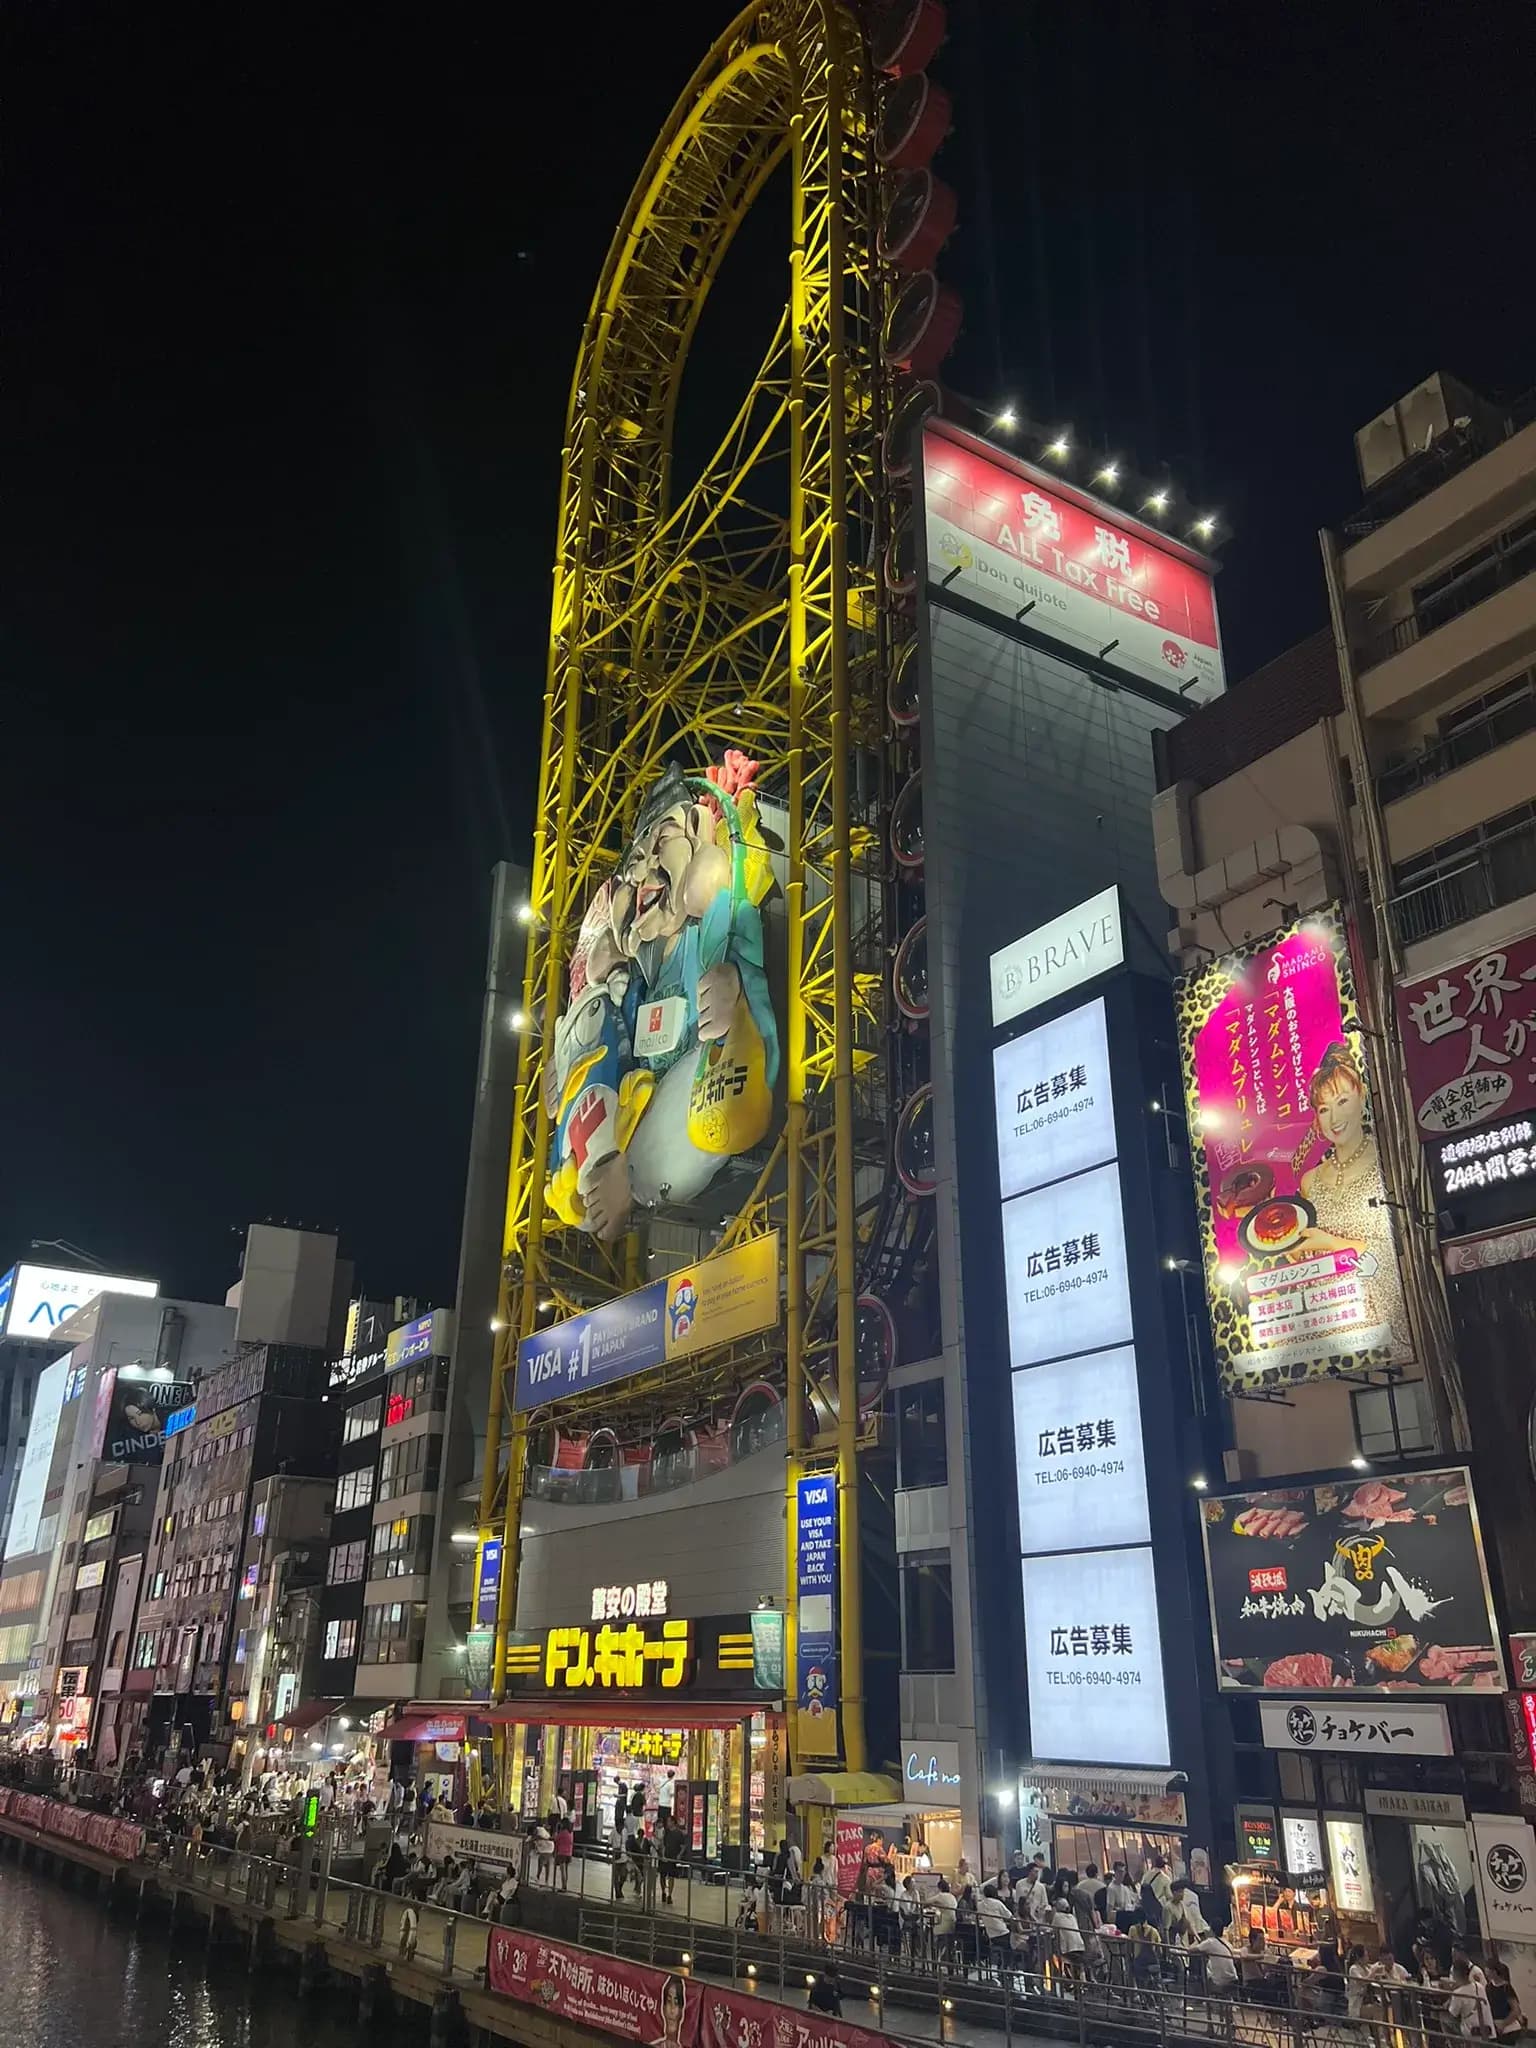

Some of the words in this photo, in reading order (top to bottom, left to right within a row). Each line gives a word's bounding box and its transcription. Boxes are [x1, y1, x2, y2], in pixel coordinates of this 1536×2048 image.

[977, 558, 1008, 584] Don
[1013, 575, 1067, 611] Quijote
[1051, 549, 1098, 592] Tax
[1105, 577, 1160, 620] Free
[1027, 914, 1114, 984] BRAVE
[1283, 952, 1326, 979] SHINCO
[1017, 1064, 1088, 1114] 広告募集
[1027, 1232, 1101, 1279] 広告募集
[1260, 1263, 1320, 1287] マダムシンコ
[527, 1347, 562, 1385] VISA
[1038, 1418, 1117, 1458] 広告募集
[1034, 1459, 1125, 1485] TEL:06-6940-4974
[803, 1487, 828, 1505] VISA
[800, 1518, 813, 1529] USE
[813, 1516, 832, 1527] YOUR
[808, 1528, 823, 1539] VISA
[800, 1541, 814, 1552] AND
[815, 1538, 832, 1549] TAKE
[805, 1551, 826, 1562] JAPAN
[800, 1575, 817, 1586] WITH
[817, 1573, 832, 1584] YOU
[807, 1562, 825, 1573] BACK
[591, 1580, 668, 1620] 驚安の殿堂
[1050, 1623, 1133, 1657] 広告募集
[1046, 1669, 1142, 1686] TEL:06-6940-4974
[1321, 1715, 1415, 1744] チョケバー
[907, 1752, 938, 1786] Cafe
[838, 1826, 863, 1842] TAKO
